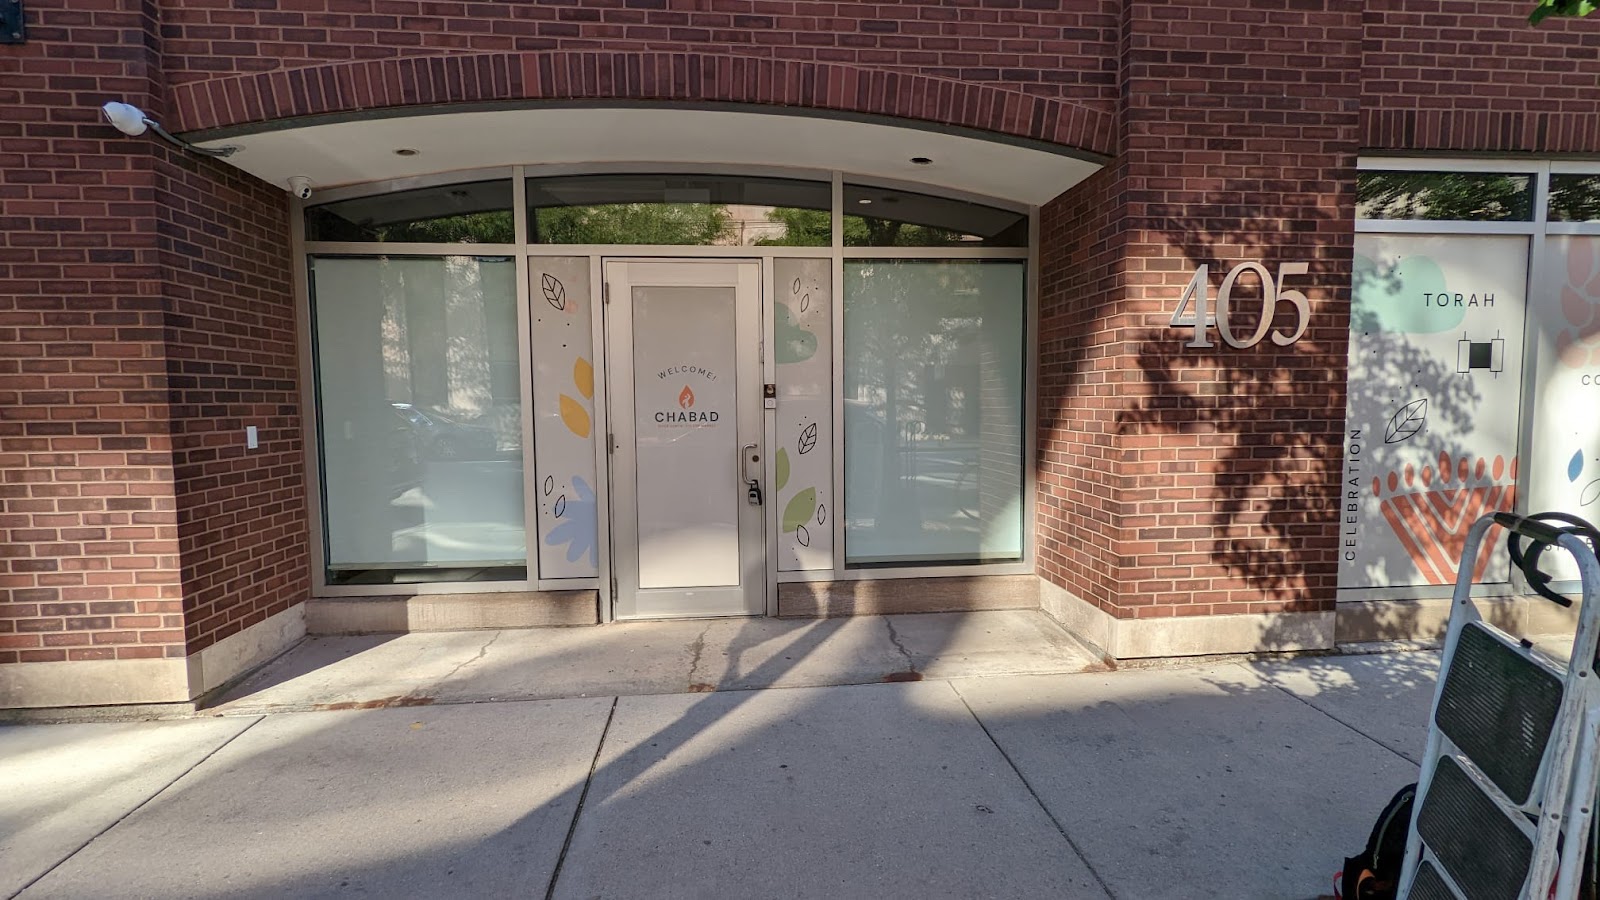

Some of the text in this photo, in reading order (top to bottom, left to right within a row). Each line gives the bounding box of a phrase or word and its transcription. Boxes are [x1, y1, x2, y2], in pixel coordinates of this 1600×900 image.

[1169, 261, 1311, 349] 405
[1423, 293, 1495, 307] TORAH
[657, 365, 718, 382] WELCOME!
[654, 411, 719, 423] CHABAD
[1344, 429, 1362, 561] CELEBRATION
